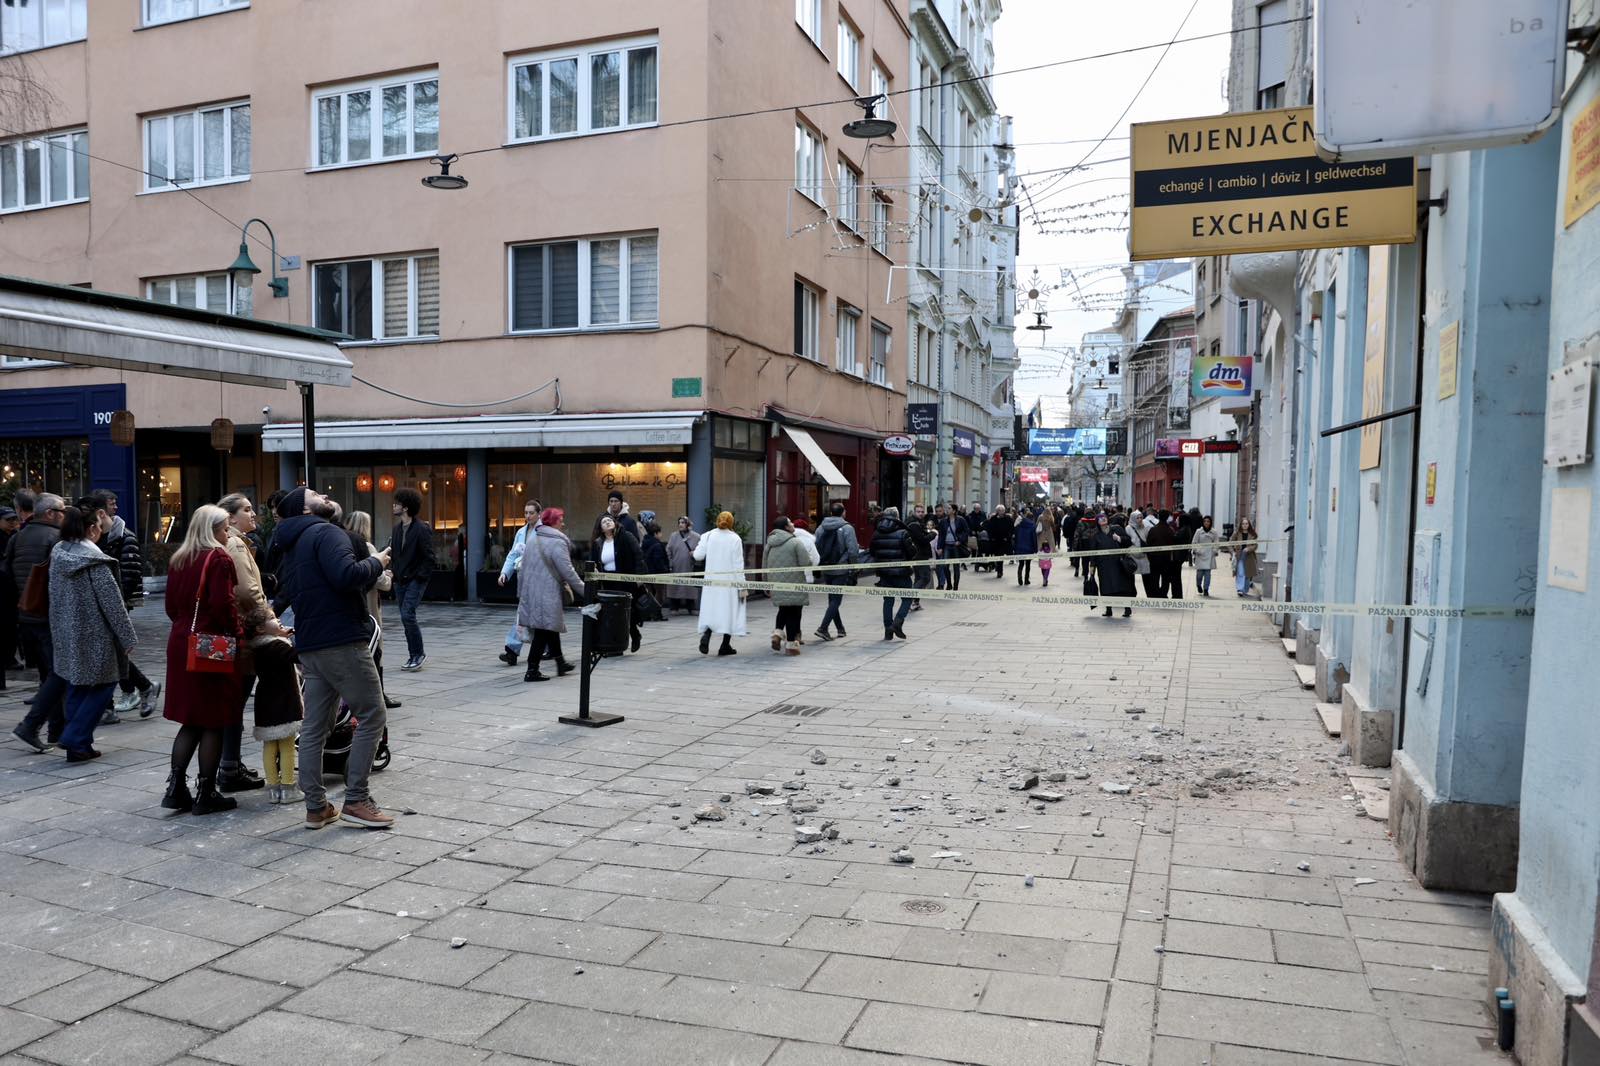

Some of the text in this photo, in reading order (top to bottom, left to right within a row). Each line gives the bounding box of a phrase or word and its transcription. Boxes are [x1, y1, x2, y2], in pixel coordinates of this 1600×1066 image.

[1159, 178, 1204, 193] echangé
[1217, 175, 1257, 189] cambio
[1314, 163, 1387, 183] geldwechsel
[1192, 206, 1349, 237] EXCHANGE
[1209, 363, 1240, 380] dm
[94, 411, 114, 424] 190
[866, 588, 886, 596] PAŽNJA
[969, 593, 1003, 601] OPASNOST
[1032, 596, 1059, 604] PAŽNJA
[1130, 600, 1160, 608] PAŽNJA
[1161, 601, 1205, 609] OPASNOST
[1242, 602, 1275, 612] PAŽNJA
[1277, 604, 1326, 613] OPASNOST
[1368, 606, 1407, 616] PAŽNJA
[1409, 609, 1466, 617] OPASNOST
